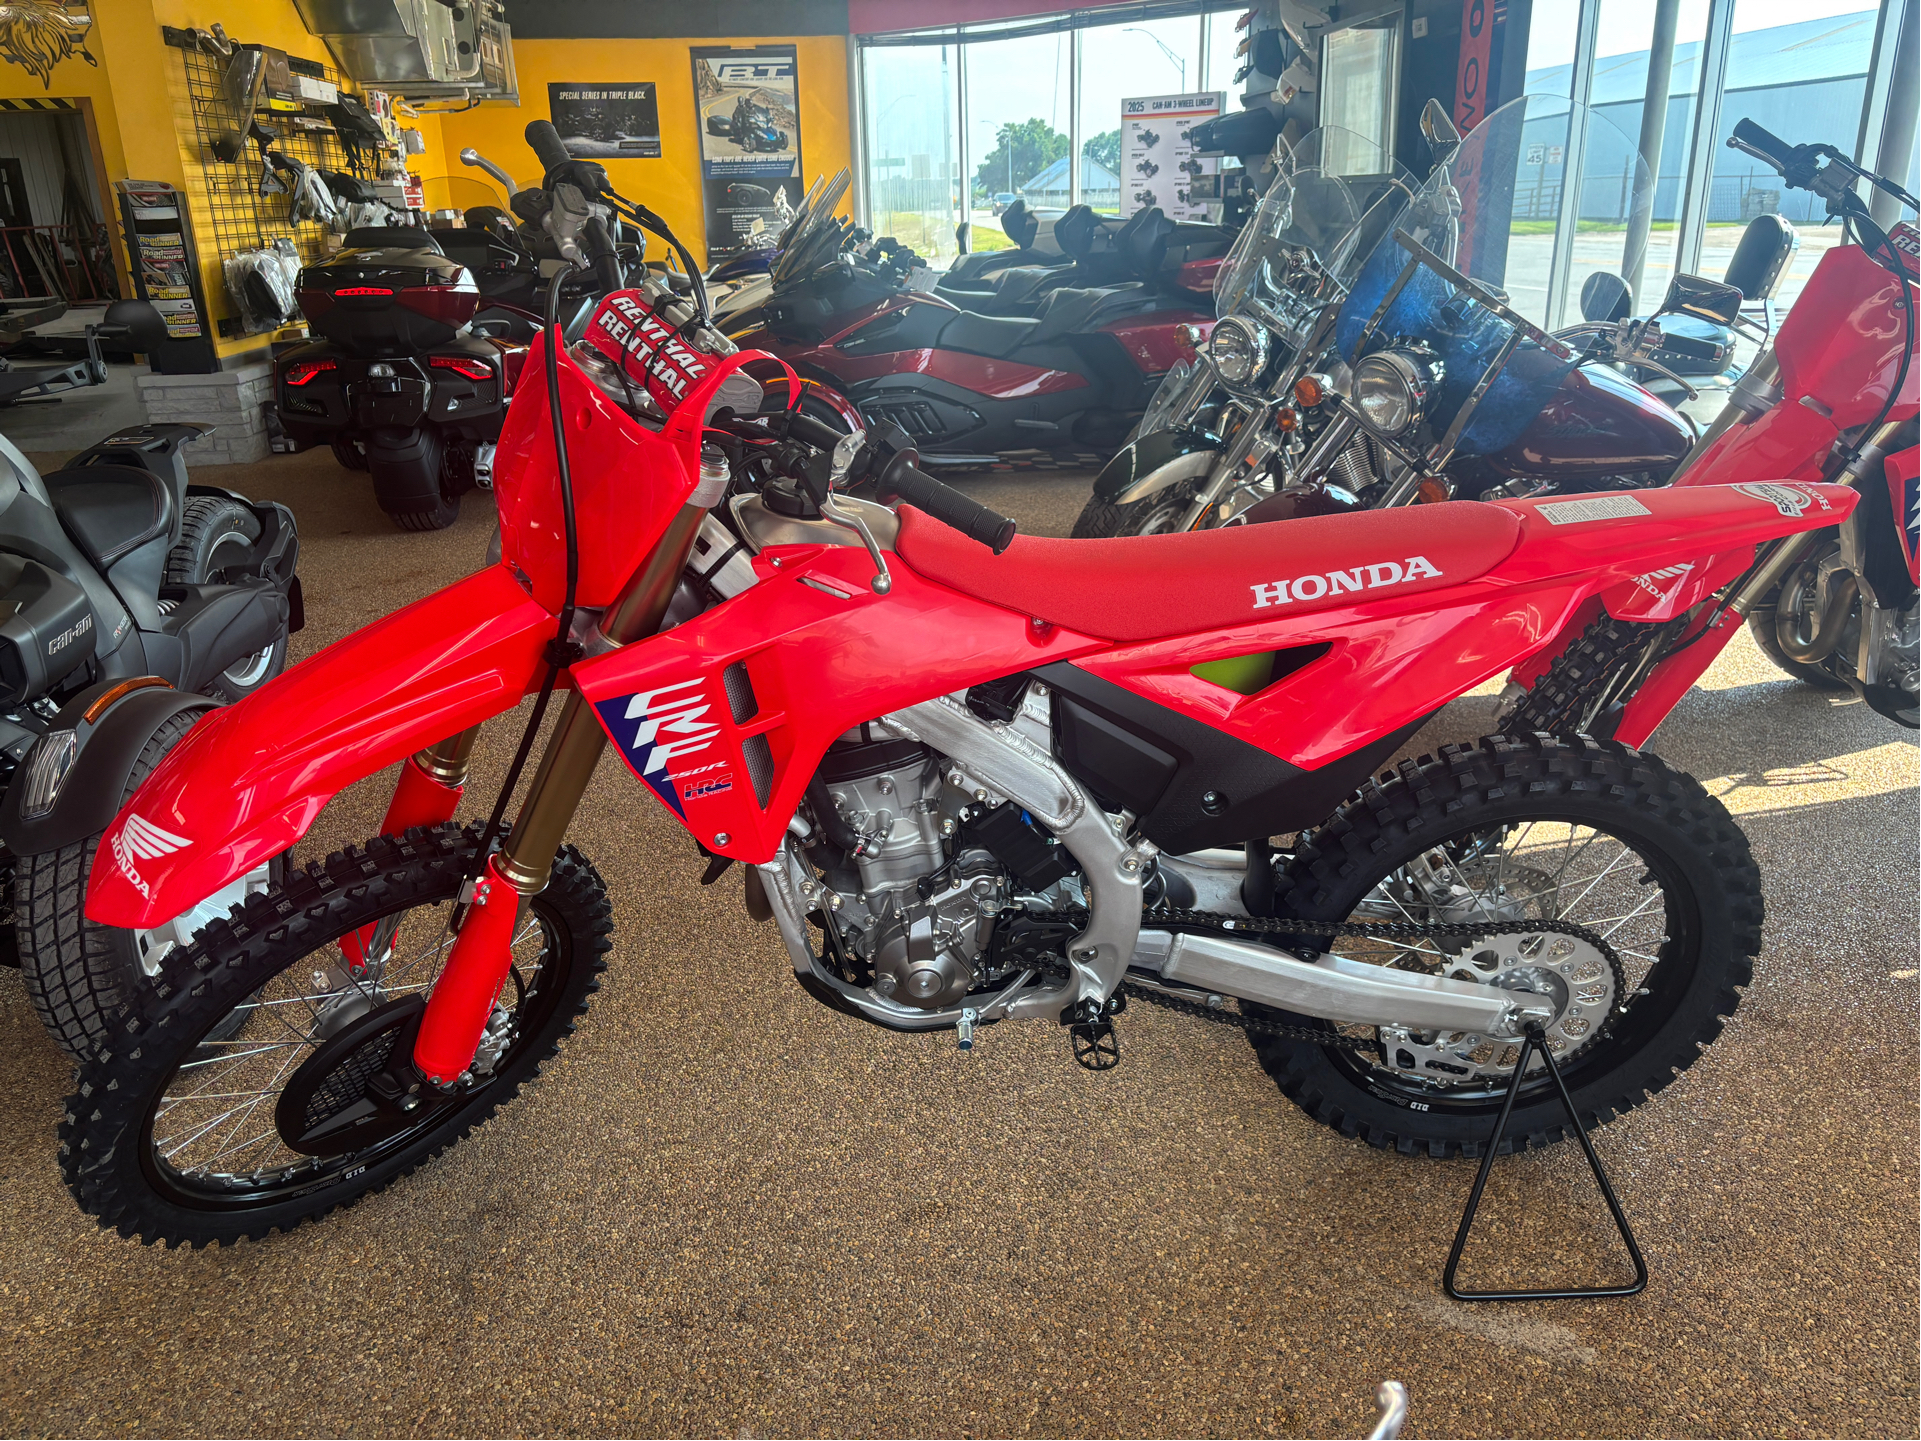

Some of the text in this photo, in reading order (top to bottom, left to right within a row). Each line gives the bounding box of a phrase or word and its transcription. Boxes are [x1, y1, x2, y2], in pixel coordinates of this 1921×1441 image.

[559, 90, 646, 100] SPECIAL SERIES IN TRIPLE BLACK.
[1128, 101, 1145, 112] 2025
[1152, 100, 1172, 110] CAN-AM
[1195, 97, 1215, 107] LINEUP
[1528, 155, 1542, 163] 45
[1891, 234, 1920, 258] RE
[611, 297, 708, 379] RENTHAL
[598, 310, 689, 400] RENTHAL
[1250, 556, 1443, 608] HONDA
[1630, 576, 1666, 603] NDA
[624, 676, 722, 776] CRF
[661, 760, 730, 782] 250R
[684, 772, 733, 799] HRC
[110, 831, 150, 900] HONDA
